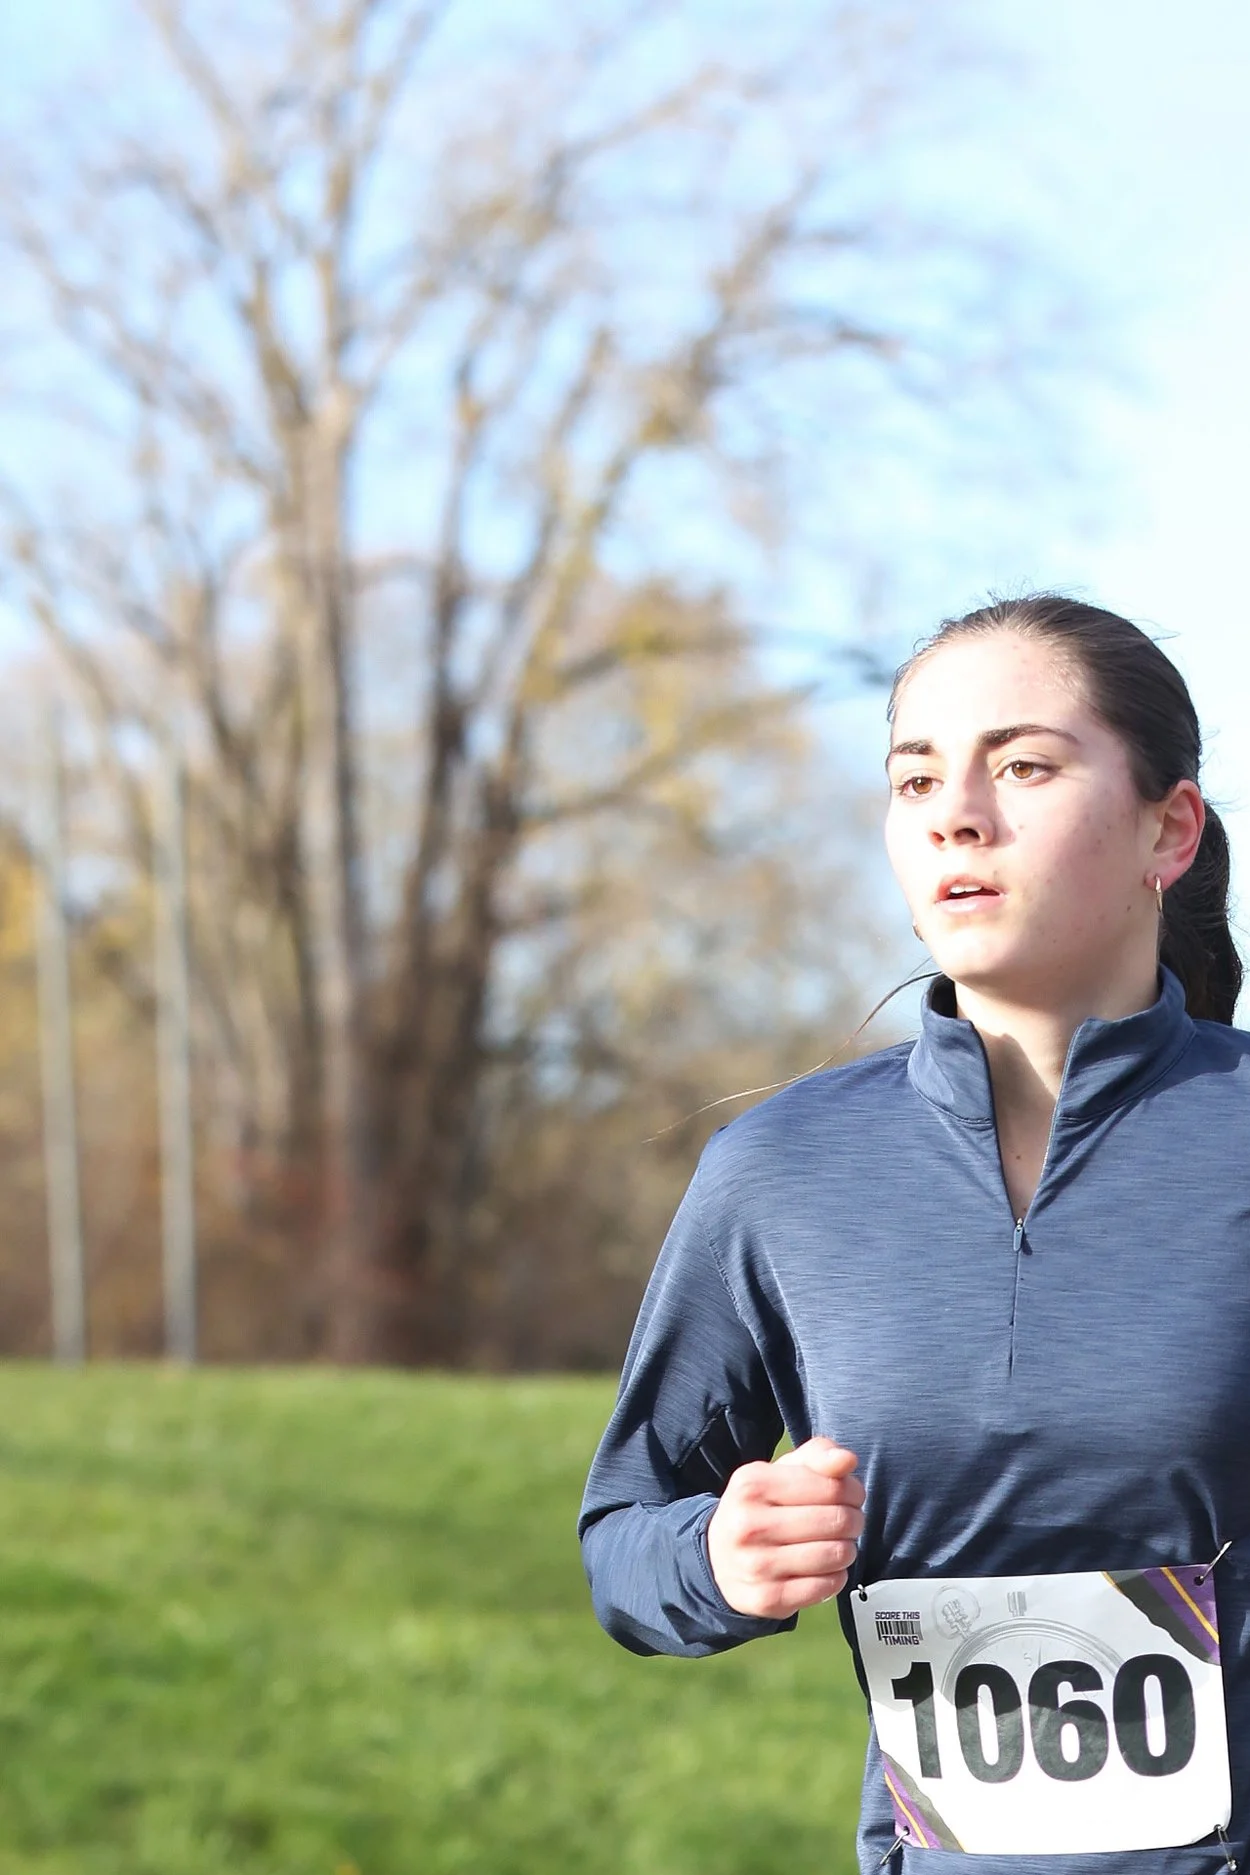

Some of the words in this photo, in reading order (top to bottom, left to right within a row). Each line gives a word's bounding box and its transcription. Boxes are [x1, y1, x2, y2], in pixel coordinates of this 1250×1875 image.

[875, 1611, 901, 1620] SCORE
[902, 1611, 920, 1620] THIS
[882, 1635, 919, 1645] TIMING
[891, 1653, 1196, 1784] 1060
